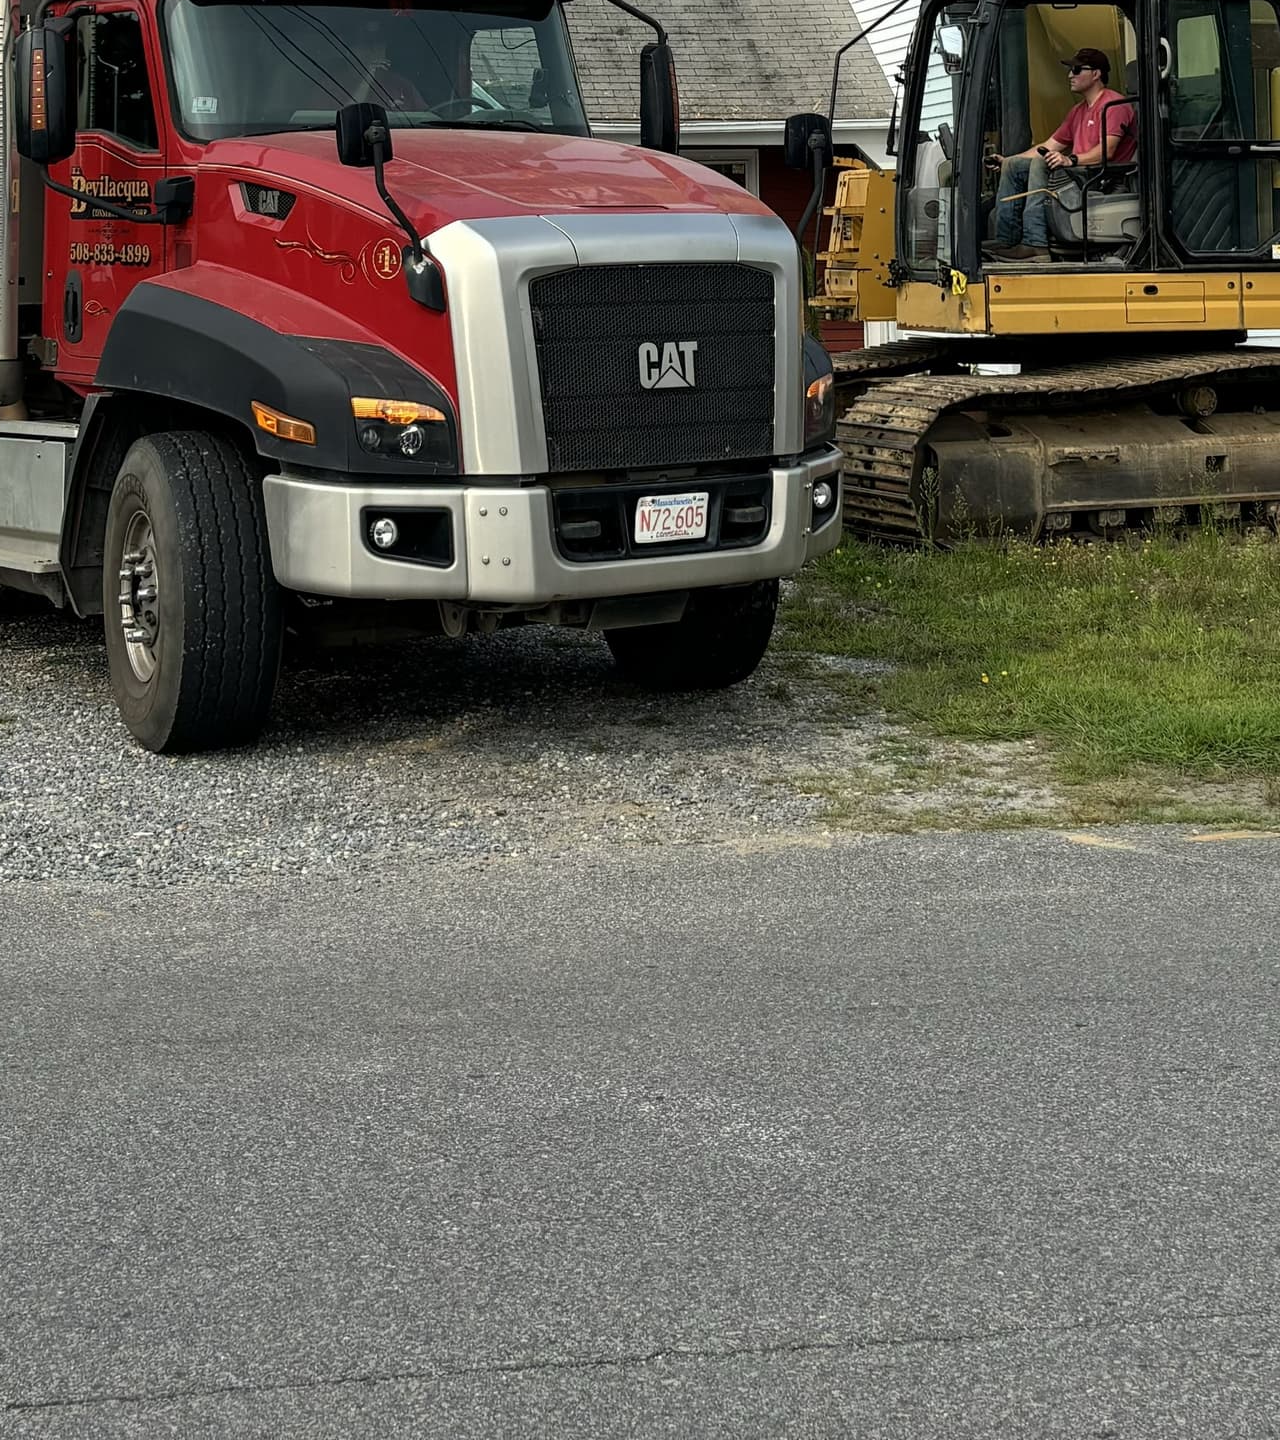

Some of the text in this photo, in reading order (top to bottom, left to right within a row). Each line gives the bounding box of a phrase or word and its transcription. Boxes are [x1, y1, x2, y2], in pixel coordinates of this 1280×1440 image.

[258, 190, 280, 213] CAT
[70, 243, 150, 263] 508-833-4899
[638, 341, 698, 390] CAT
